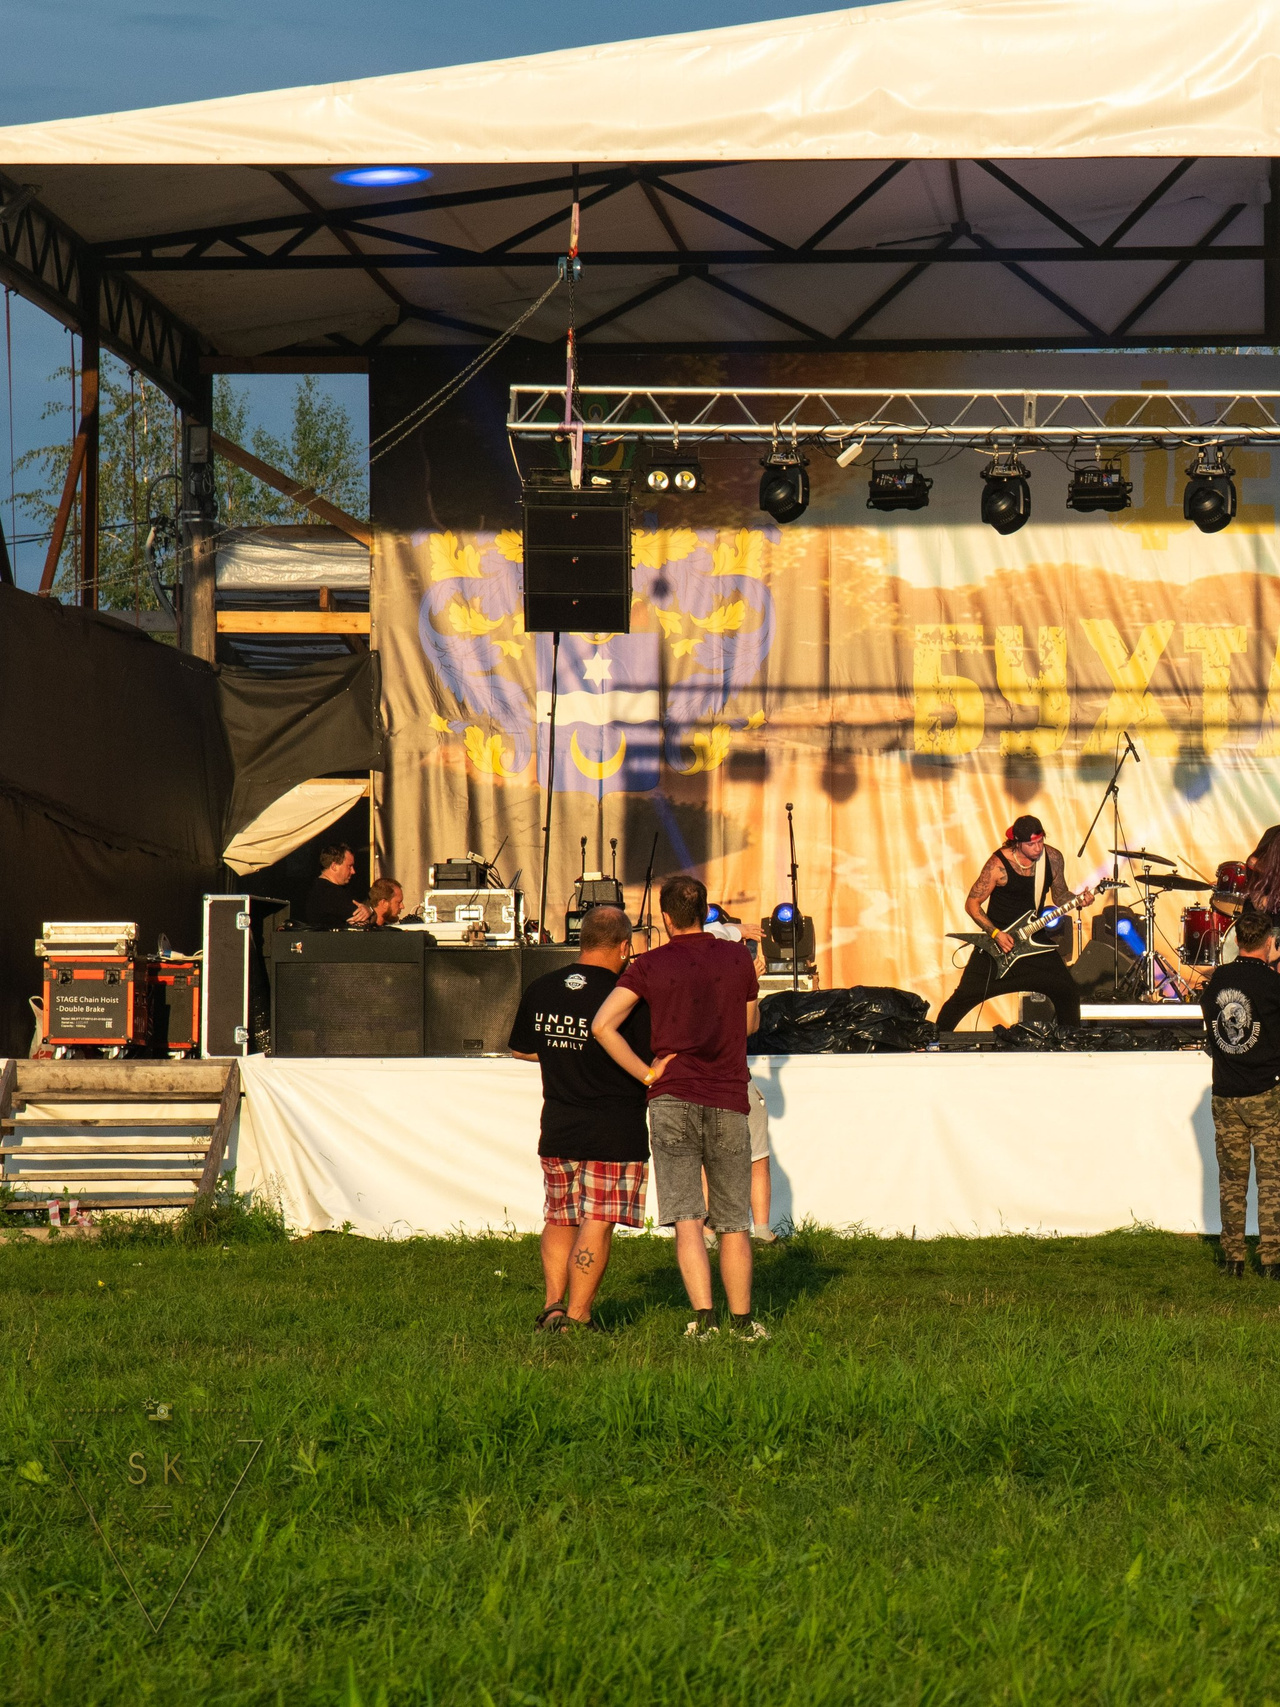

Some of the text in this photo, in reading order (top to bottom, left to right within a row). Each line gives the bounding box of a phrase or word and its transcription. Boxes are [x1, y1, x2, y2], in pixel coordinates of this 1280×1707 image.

[535, 1012, 588, 1028] UNDE
[534, 1024, 589, 1038] GROUN
[547, 1039, 584, 1051] FAMILY
